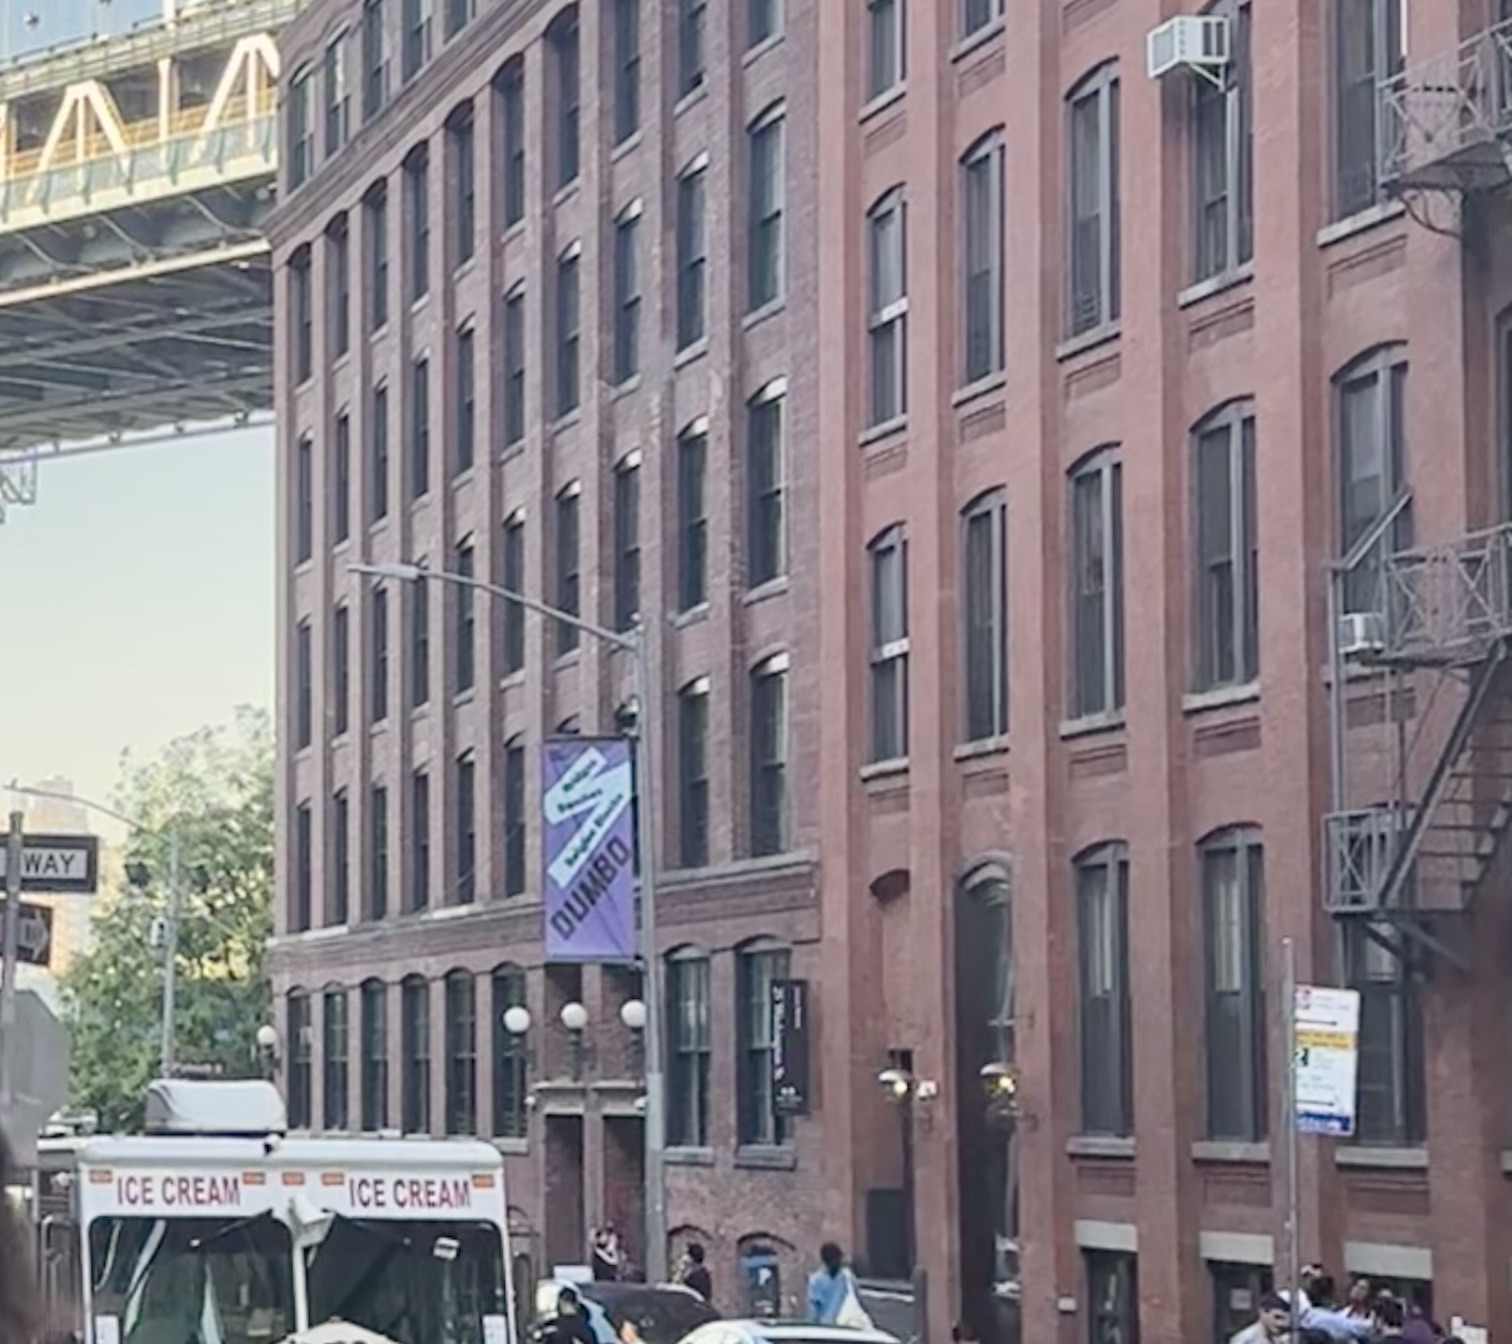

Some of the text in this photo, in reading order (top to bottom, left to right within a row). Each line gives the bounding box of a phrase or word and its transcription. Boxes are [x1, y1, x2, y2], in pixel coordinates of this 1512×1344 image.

[24, 853, 76, 874] WAY
[550, 835, 630, 941] DUMBO
[117, 1176, 240, 1205] ICE CREAM
[349, 1178, 471, 1207] ICE CREAM
